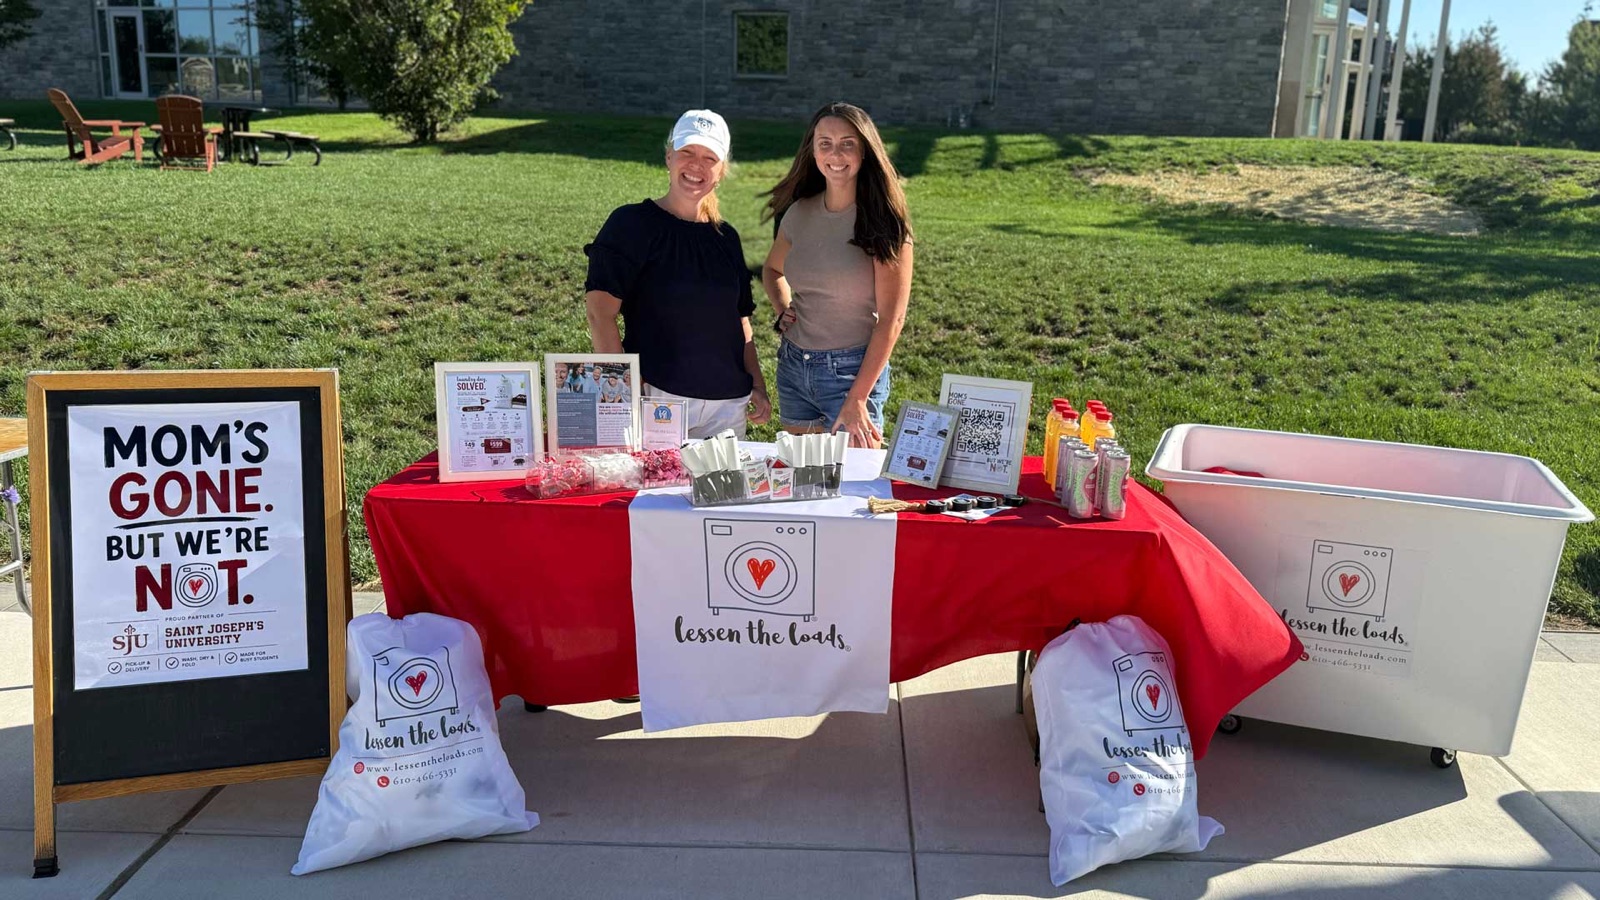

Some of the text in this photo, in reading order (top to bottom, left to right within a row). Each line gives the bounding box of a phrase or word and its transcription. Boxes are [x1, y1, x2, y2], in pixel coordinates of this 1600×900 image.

[456, 382, 486, 390] SOLVED.
[949, 392, 968, 400] MOM'S
[104, 420, 269, 468] MOM'S
[108, 468, 274, 520] GONE.
[106, 526, 270, 561] BUT WE'RE
[165, 621, 264, 638] SAINT JOSEPH'S
[674, 615, 740, 644] lessen
[746, 619, 785, 646] the
[1332, 617, 1359, 637] the
[113, 634, 149, 655] SJU
[165, 634, 241, 648] UNIVERSITY
[408, 721, 438, 745] the
[1154, 734, 1176, 758] the
[366, 746, 484, 773] www.lessentheloads.com
[393, 768, 457, 786] 610-466-5331
